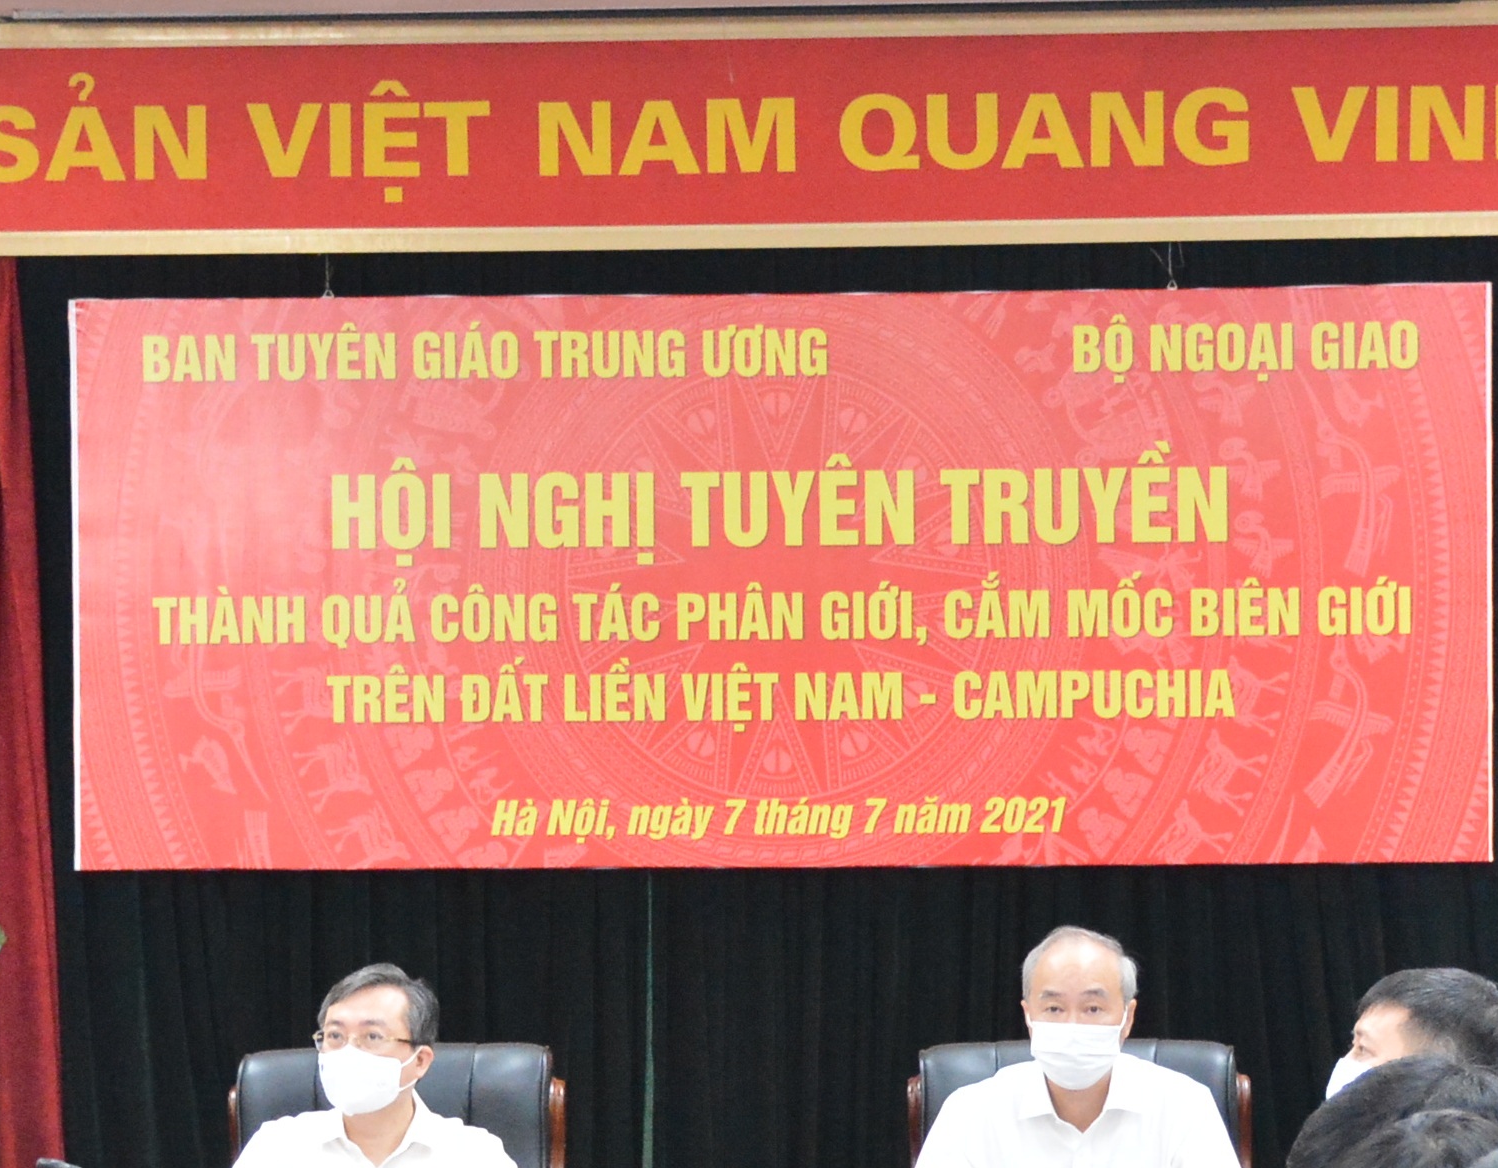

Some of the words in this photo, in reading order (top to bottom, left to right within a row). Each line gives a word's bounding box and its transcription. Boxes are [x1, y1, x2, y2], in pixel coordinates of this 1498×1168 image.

[248, 81, 489, 202] VIỆT
[539, 98, 795, 175] NAM
[840, 88, 1248, 171] QUANG
[144, 334, 235, 381] BAN
[252, 322, 396, 381] TUYÊN
[413, 321, 519, 379] GIÁO
[534, 329, 686, 378] TRUNG
[703, 324, 828, 377] ƯƠNG
[1073, 314, 1133, 383] BỘ
[1150, 323, 1293, 382] NGOẠI
[1311, 320, 1419, 370] GIAO
[332, 457, 451, 566] HỘI
[480, 472, 655, 565] NGHỊ
[681, 453, 915, 548] TUYÊN
[940, 440, 1228, 544] TRUYỀN
[153, 586, 305, 644] THÀNH
[322, 578, 415, 648] QUẢ
[431, 584, 557, 642] CÔNG
[573, 582, 660, 641] TÁC
[677, 582, 803, 640] PHÂN
[821, 580, 927, 645] GIỚI,
[944, 571, 1050, 639] CẮM
[1068, 572, 1173, 638] MỐC
[1190, 577, 1300, 636] BIÊN
[1317, 576, 1411, 636] GIỚI
[327, 665, 445, 723] TRÊN
[460, 656, 548, 722] ĐẤT
[564, 657, 665, 722] LIỀN
[681, 662, 779, 732] VIỆT
[795, 671, 903, 720] NAM
[954, 669, 1236, 720] CAMPUCHIA
[491, 799, 538, 836] Hà
[547, 798, 615, 844] Nội,
[627, 798, 715, 840] ngày
[724, 798, 747, 835] 7
[754, 797, 854, 839] tháng
[865, 798, 887, 834] 7
[894, 796, 972, 834] năm
[980, 796, 1066, 833] 2021
